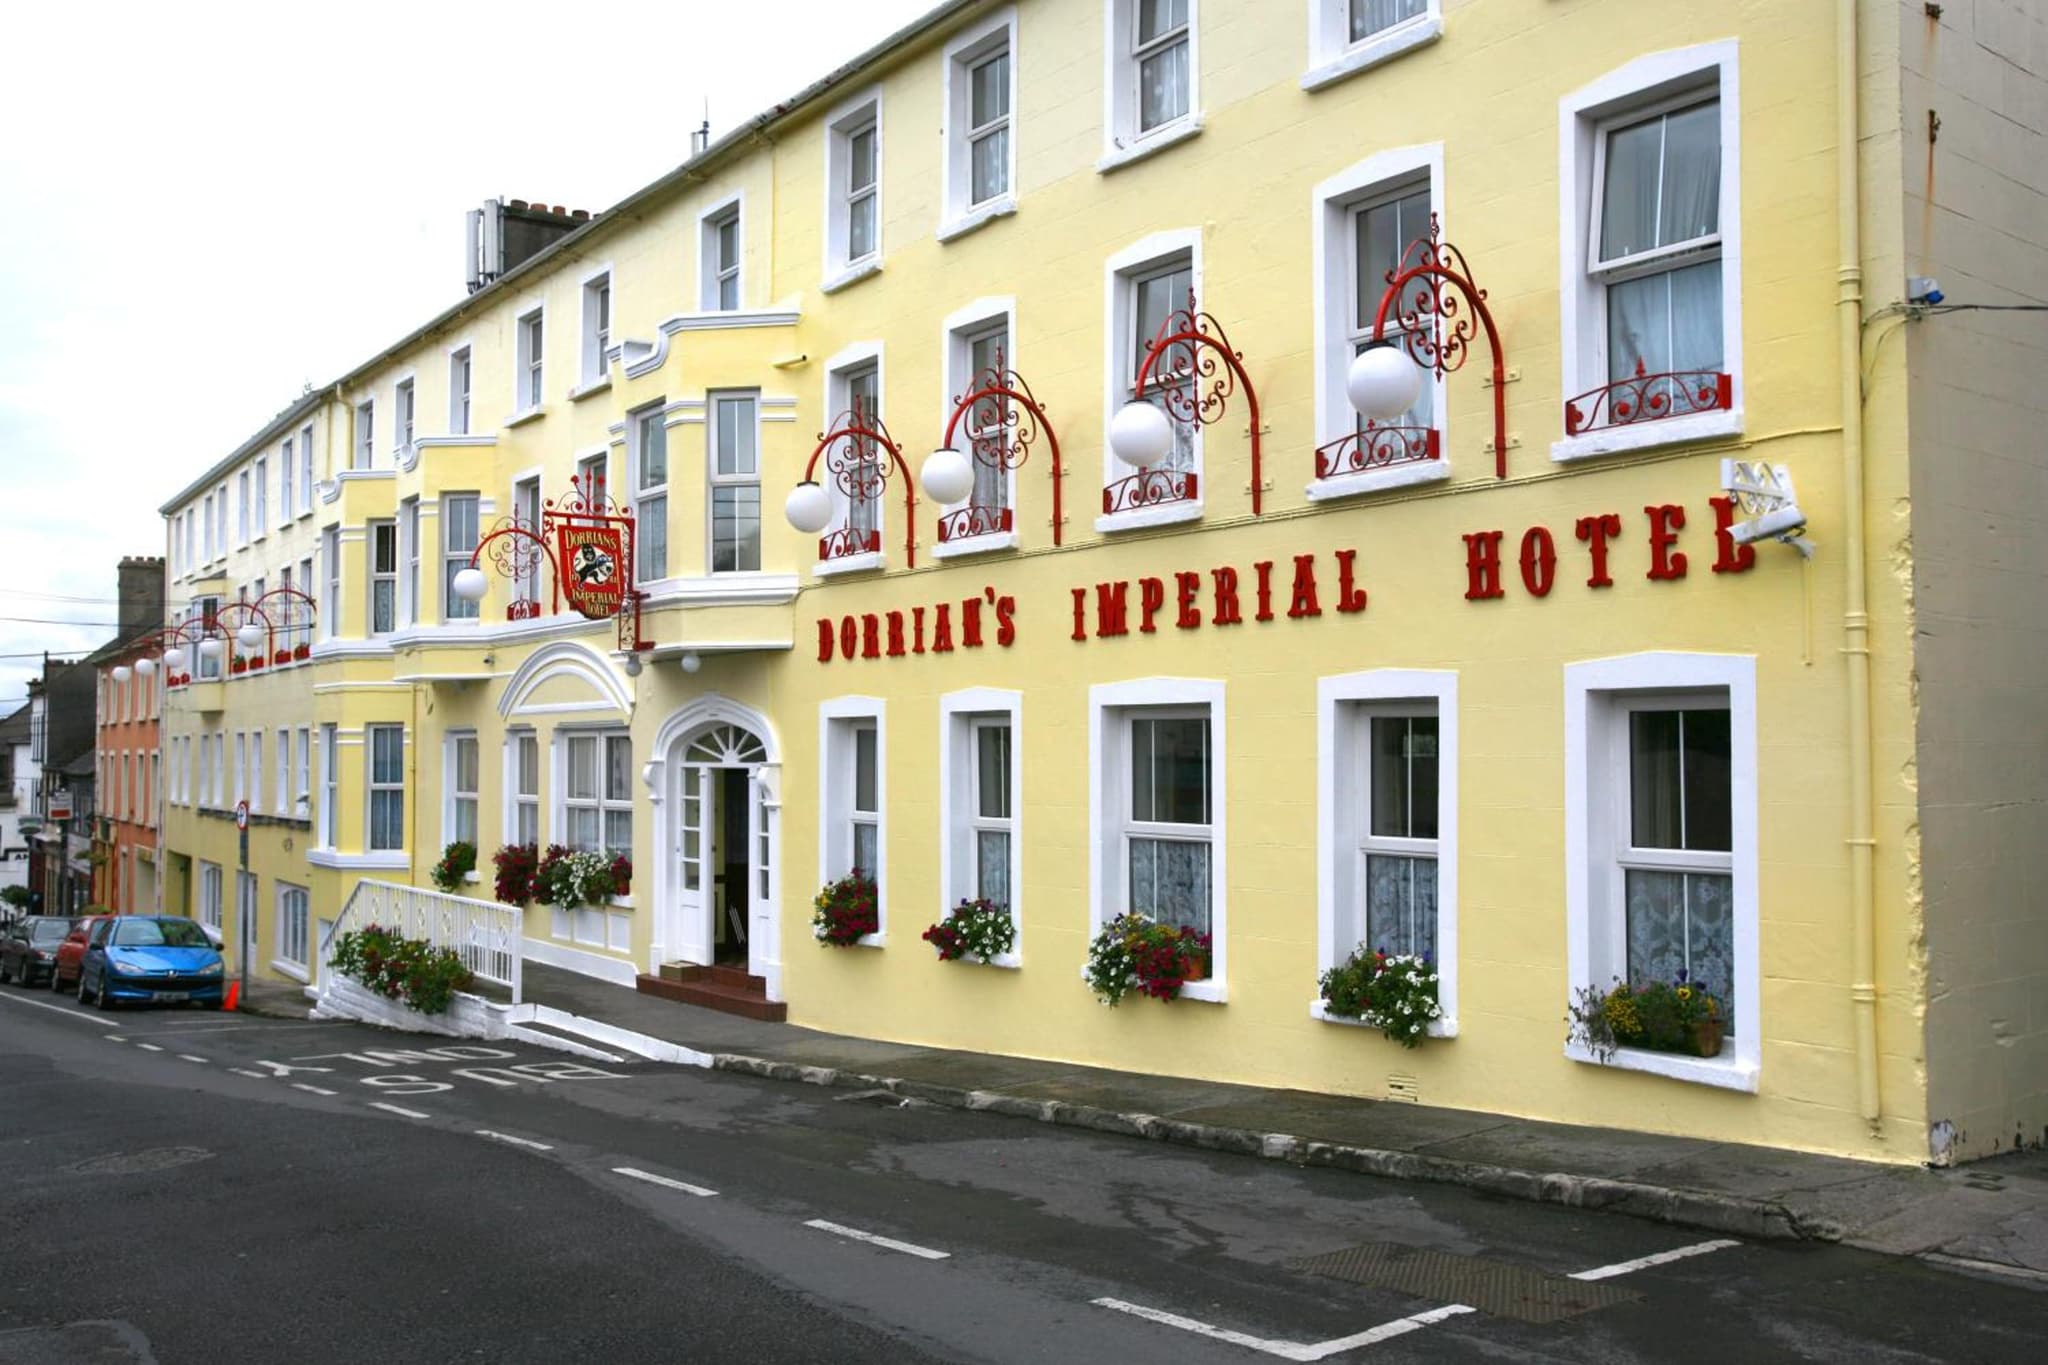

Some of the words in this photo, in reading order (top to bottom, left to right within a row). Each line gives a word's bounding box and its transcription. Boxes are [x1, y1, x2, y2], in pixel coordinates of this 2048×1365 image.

[565, 529, 617, 550] DORRIAN'S
[818, 587, 1015, 663] DORRIAN'S
[1071, 549, 1367, 641] IMPERIAL
[1463, 496, 1755, 599] HOTEL
[572, 589, 619, 605] IMPERIAL
[585, 600, 609, 616] HOTEL
[360, 1060, 632, 1094] BUS
